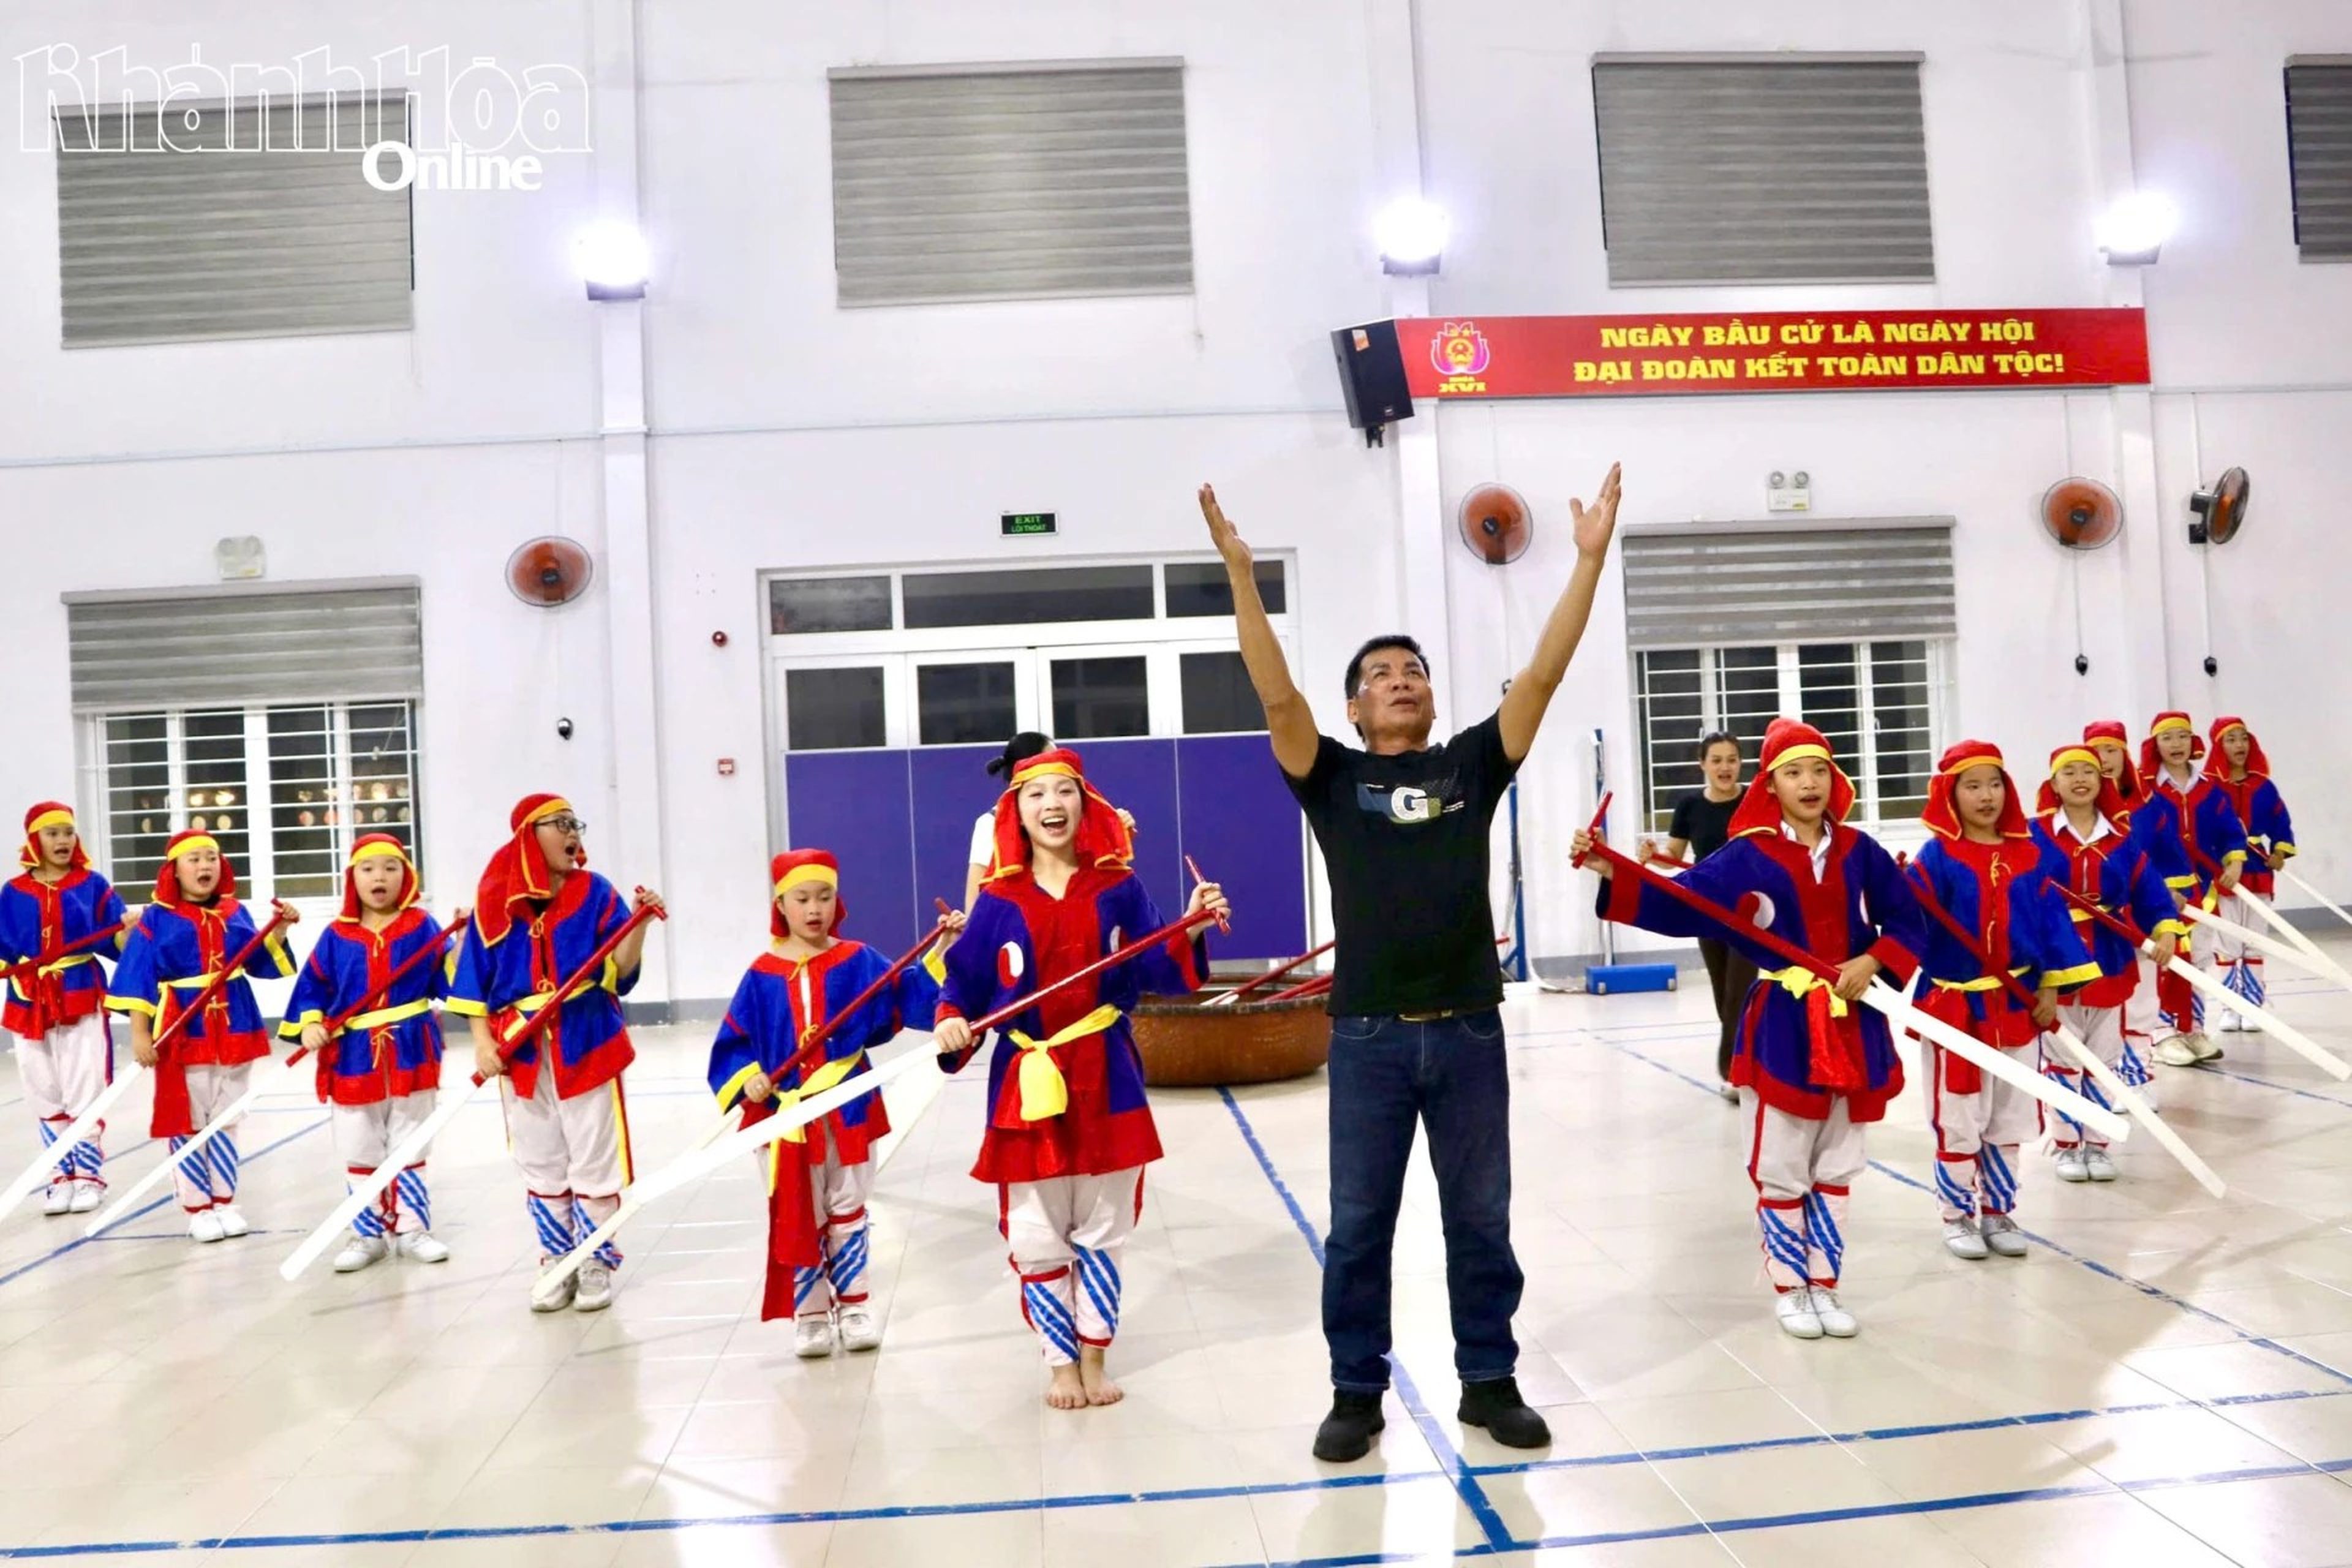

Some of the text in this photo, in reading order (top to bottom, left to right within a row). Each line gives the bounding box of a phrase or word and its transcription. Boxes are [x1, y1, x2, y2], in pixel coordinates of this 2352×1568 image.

[1600, 318, 2035, 348] NGÀY BẦU CỬ LÀ NGÀY HỘI
[1573, 350, 2065, 384] ĐẠI ĐOÀN KẾT TOÀN DÂN TỘC!
[1439, 382, 1486, 392] XVI
[1391, 786, 1429, 820] G
